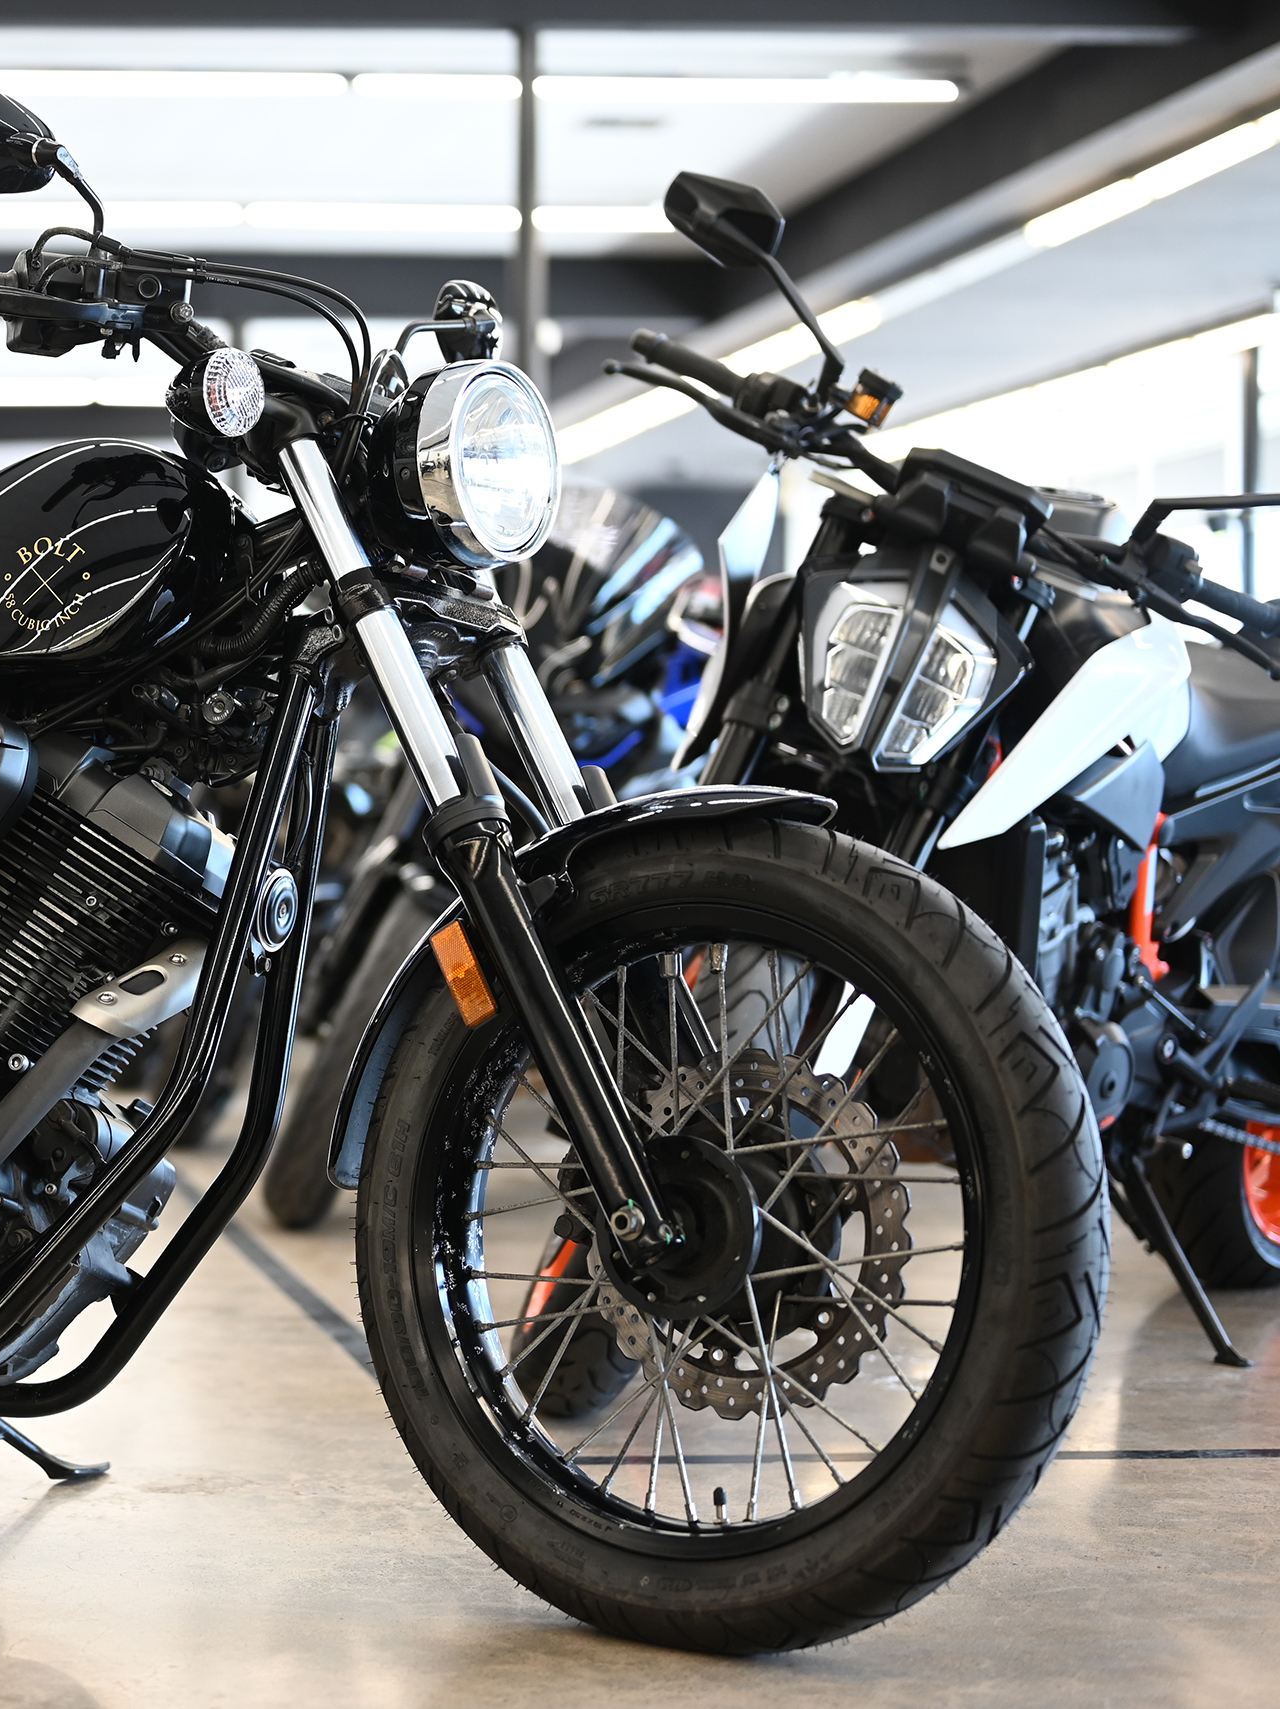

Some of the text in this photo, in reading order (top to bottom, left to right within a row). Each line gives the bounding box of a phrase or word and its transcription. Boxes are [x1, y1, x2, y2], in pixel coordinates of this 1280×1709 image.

[15, 536, 86, 565] BOLT
[11, 608, 51, 631] CUBIC
[54, 592, 85, 628] INCH
[589, 870, 694, 909] SR777
